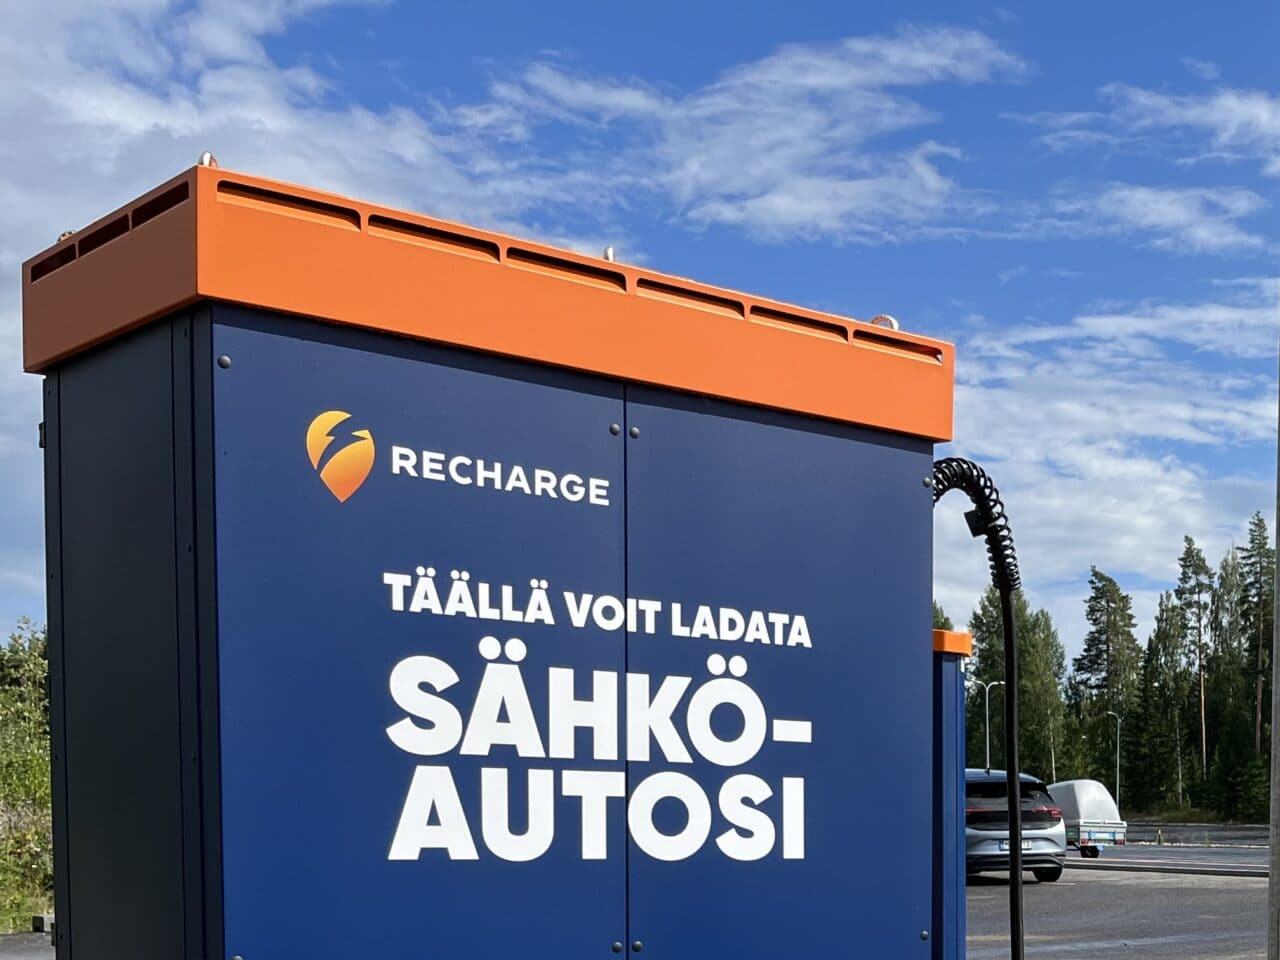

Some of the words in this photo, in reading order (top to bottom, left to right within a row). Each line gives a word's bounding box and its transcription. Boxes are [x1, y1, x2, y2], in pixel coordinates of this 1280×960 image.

[391, 444, 610, 507] RECHARGE
[382, 566, 555, 626] TÄÄLLÄ
[563, 591, 663, 635] VOIT
[671, 602, 813, 649] LADATA
[385, 636, 813, 768] SÄHKÖ-
[387, 764, 806, 862] AUTOSI
